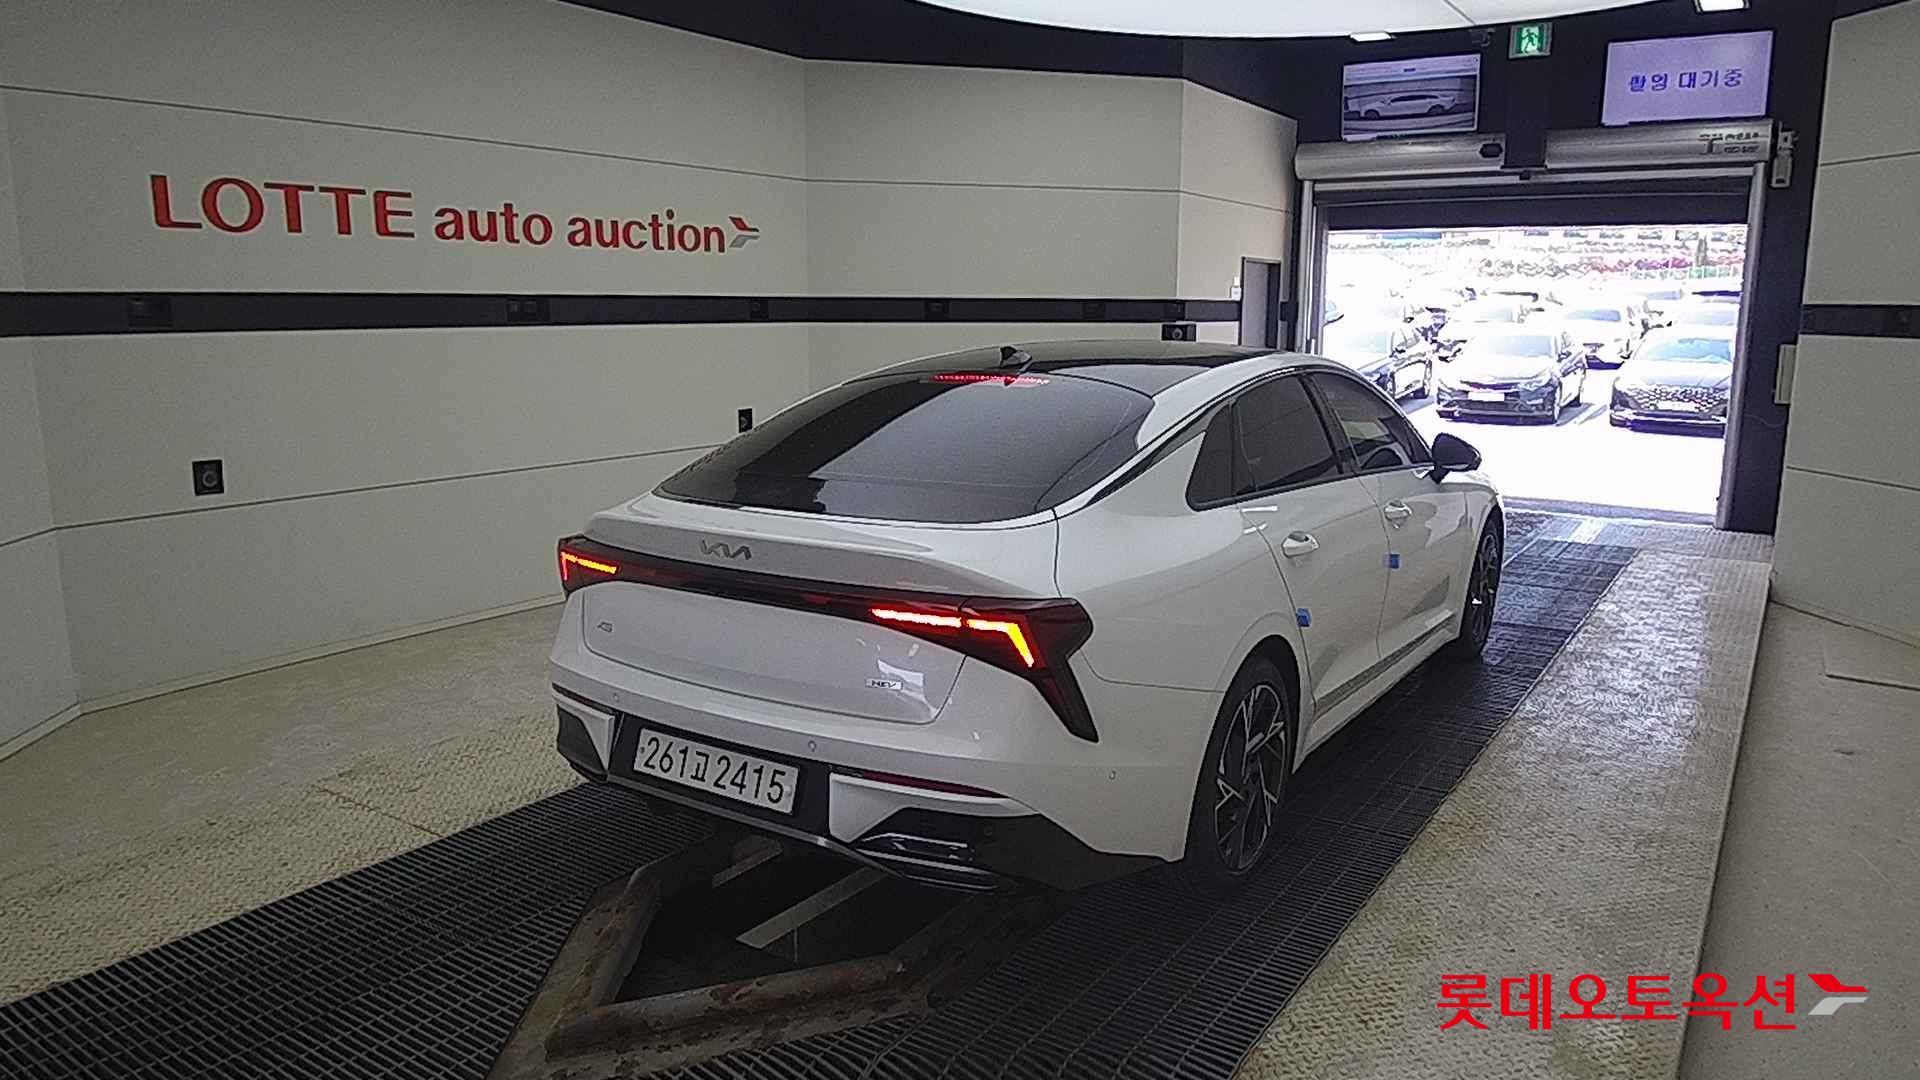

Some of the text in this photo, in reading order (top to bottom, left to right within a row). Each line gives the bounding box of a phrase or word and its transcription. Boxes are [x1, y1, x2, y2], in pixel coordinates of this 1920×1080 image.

[1679, 68, 1742, 89] 대기중
[150, 174, 726, 253] LOTTE auto auction
